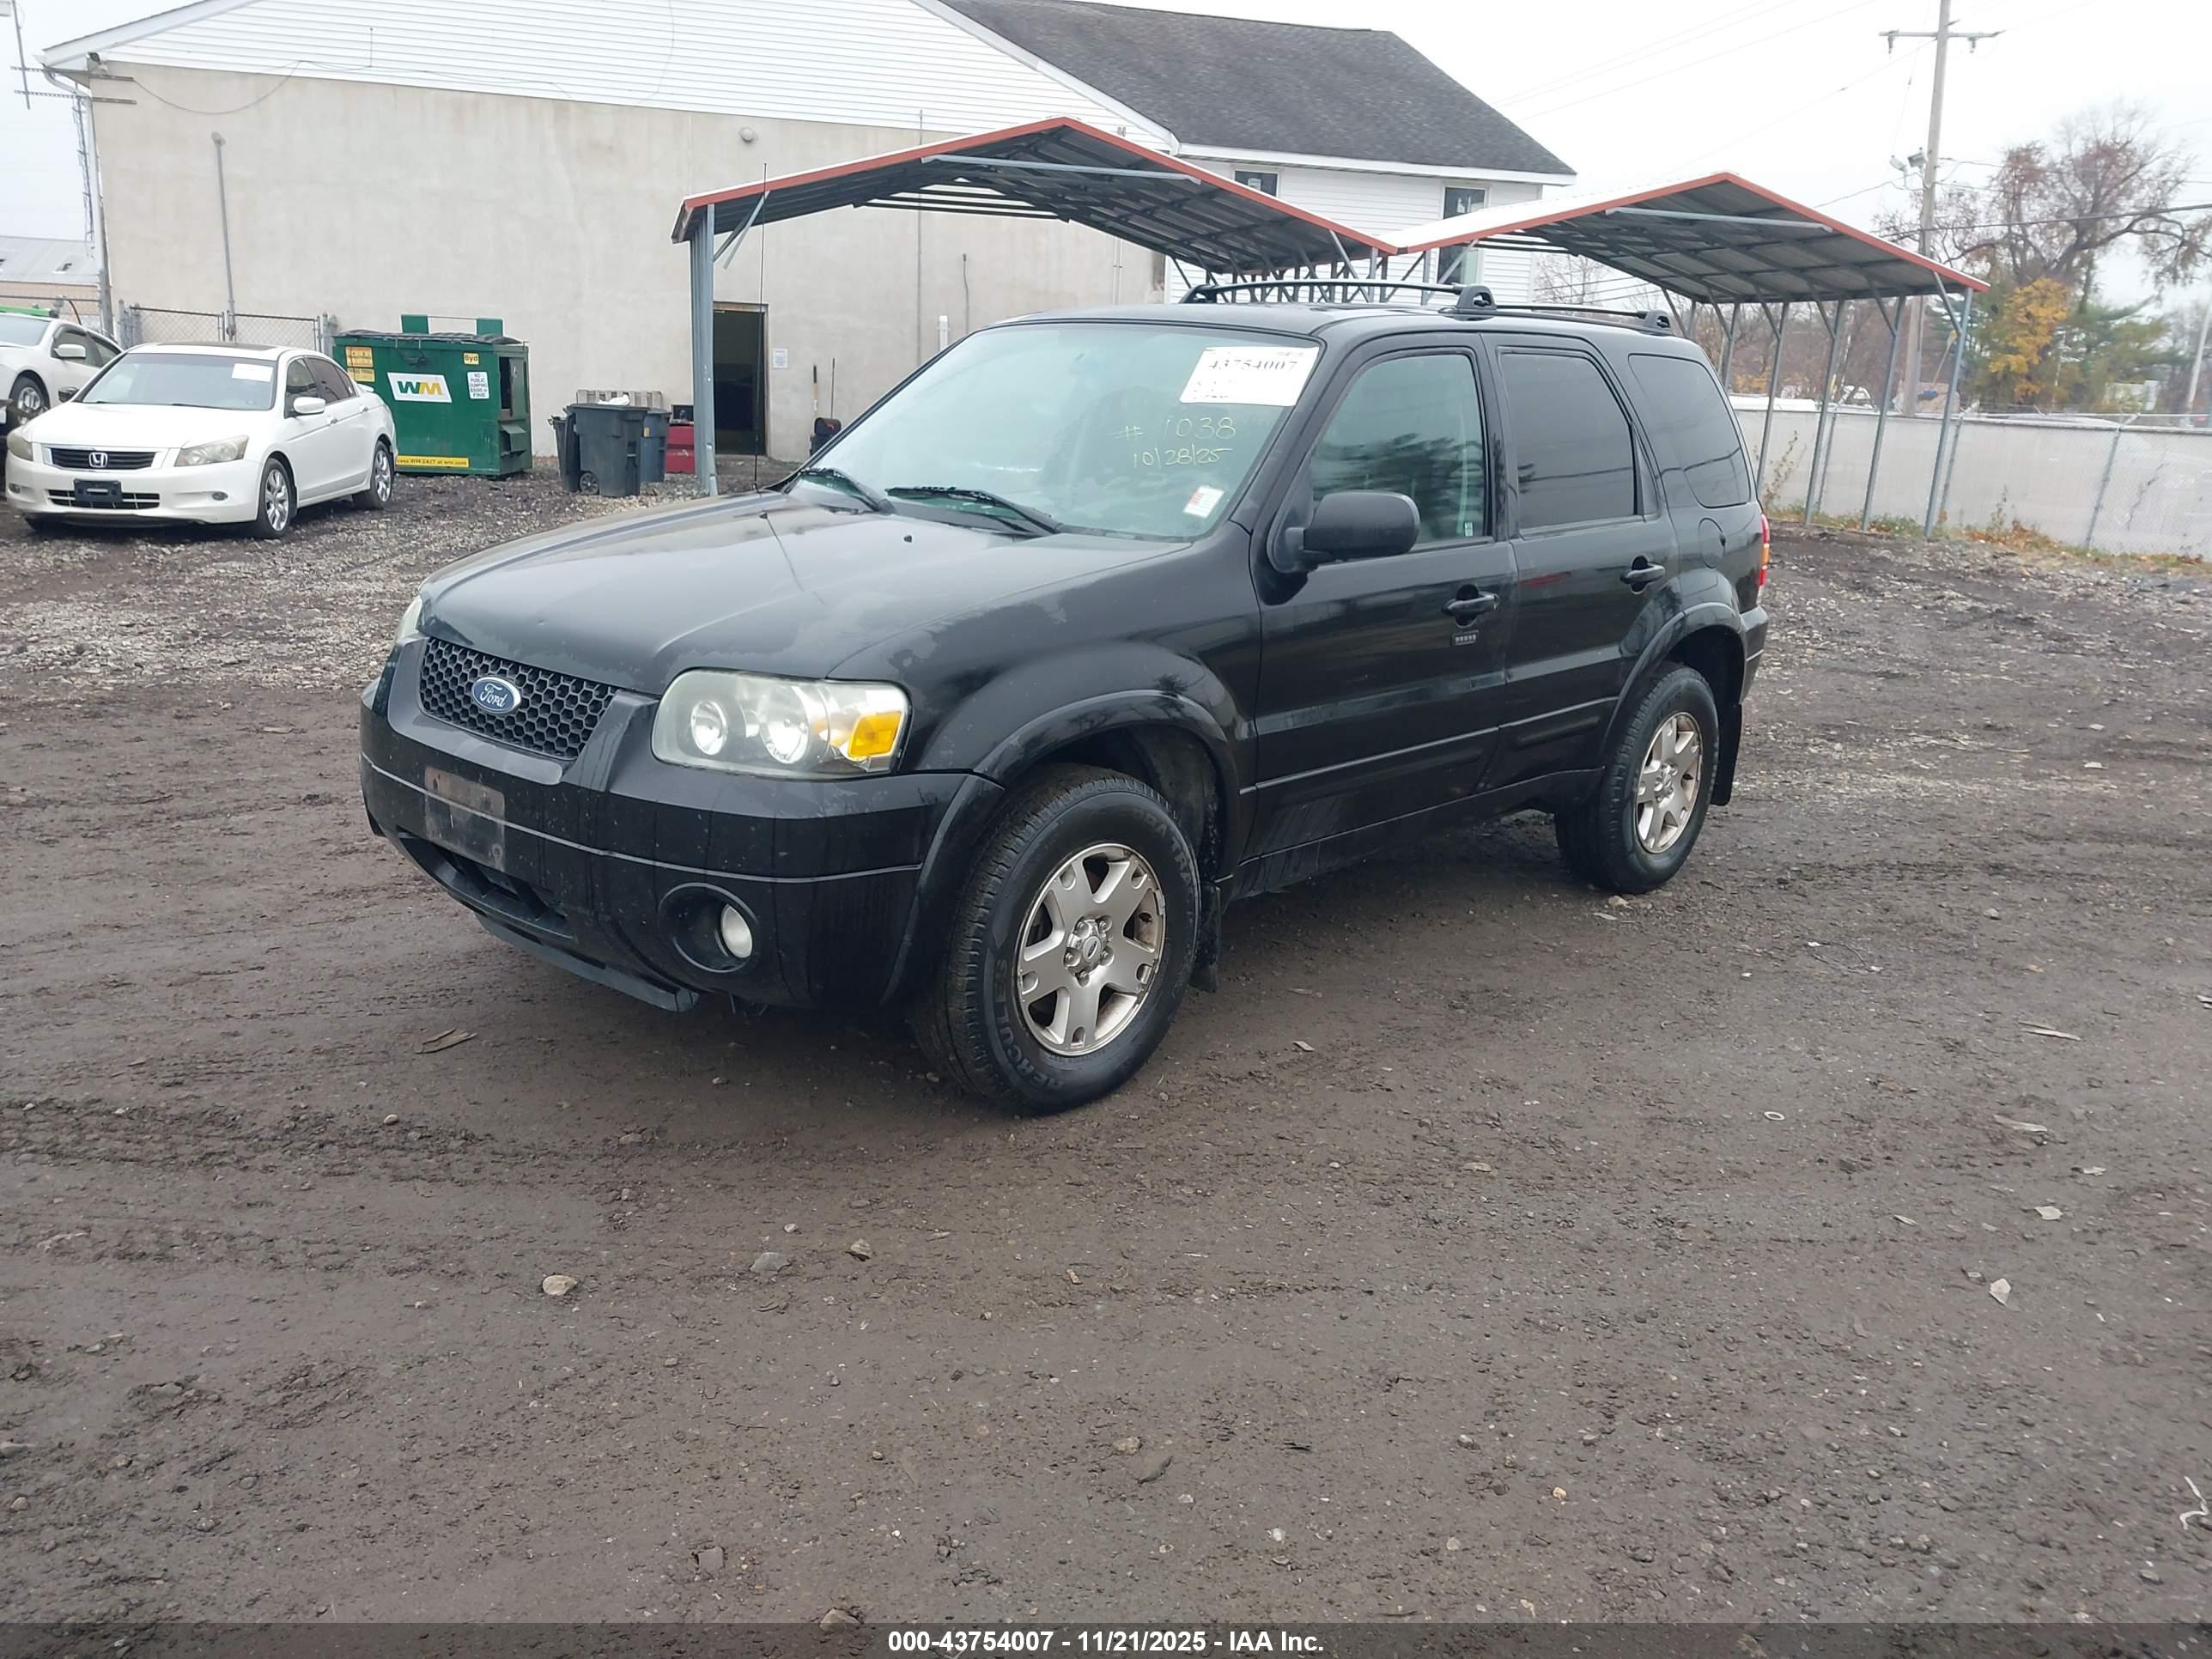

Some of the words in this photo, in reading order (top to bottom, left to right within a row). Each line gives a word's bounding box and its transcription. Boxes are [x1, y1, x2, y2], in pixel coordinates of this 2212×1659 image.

[397, 380, 443, 395] WM
[1165, 417, 1237, 439] 1038
[480, 683, 507, 708] Ford
